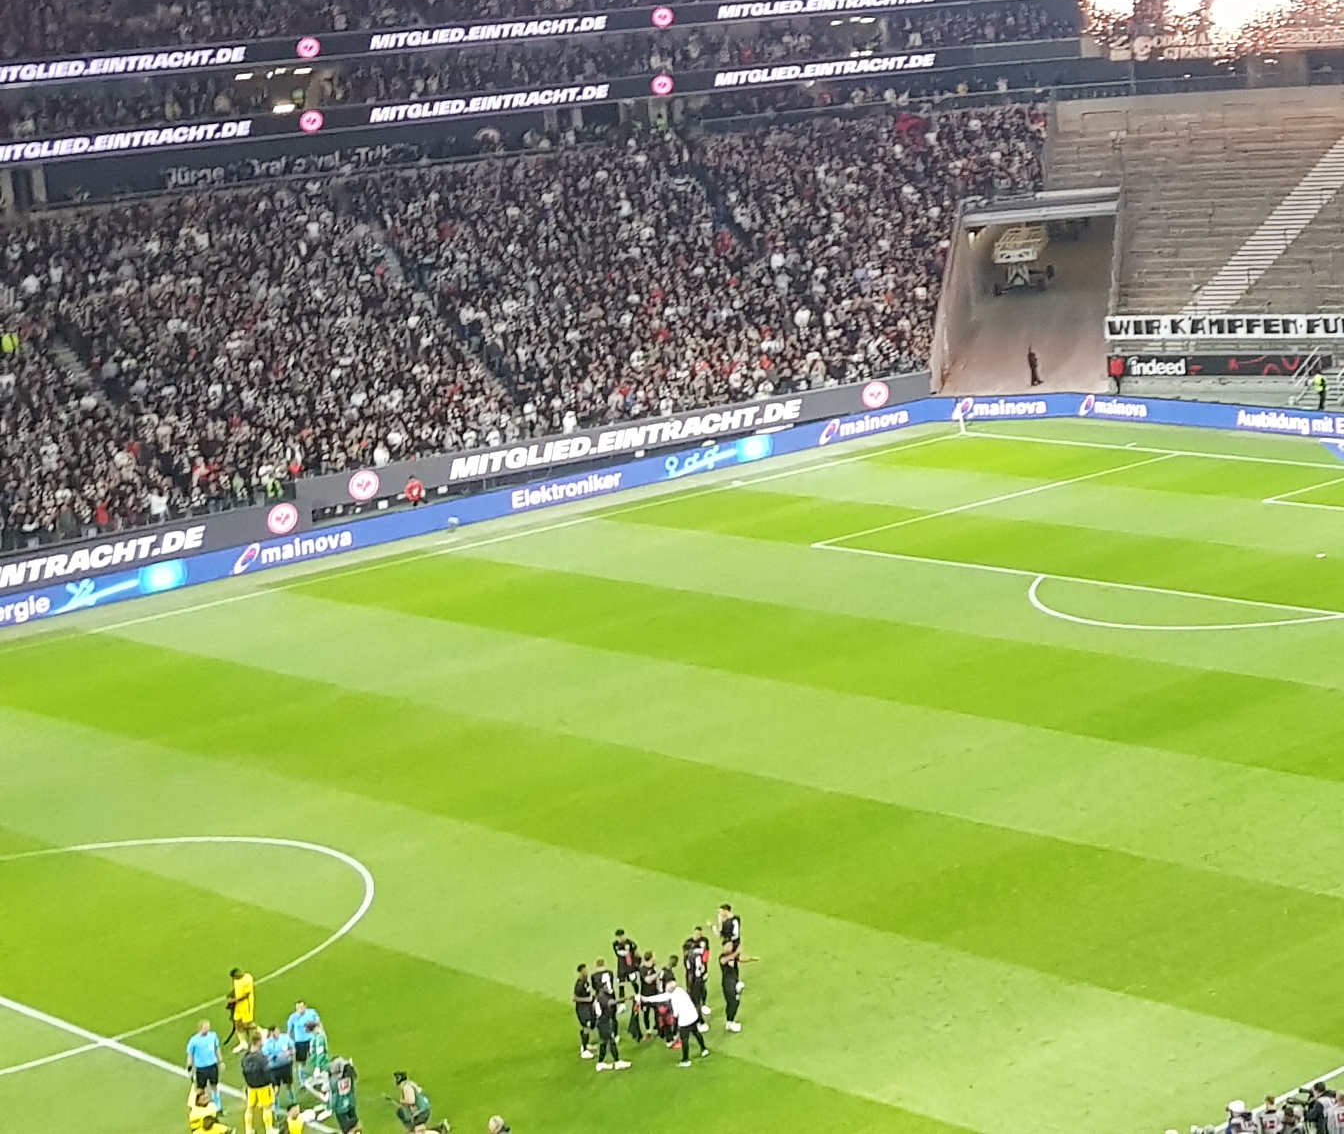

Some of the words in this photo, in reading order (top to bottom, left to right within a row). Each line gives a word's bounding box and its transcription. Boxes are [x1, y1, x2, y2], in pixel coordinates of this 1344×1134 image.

[370, 16, 608, 50] MITGLIED.EINTRACHT.DE
[714, 52, 936, 88] MITGLIED.EINTRACHT.DE
[370, 84, 609, 123] MITGLIED.EINTRACHT.DE
[1107, 318, 1162, 336] WIR
[1127, 357, 1187, 377] indeed
[840, 409, 910, 437] mainova
[1094, 400, 1149, 418] mainova
[1236, 409, 1311, 436] Ausbildung
[1313, 416, 1334, 433] mit
[449, 398, 804, 481] MITGLIED.EINTRACHT.DE
[511, 471, 623, 510] Elektroniker
[261, 527, 353, 565] mainova
